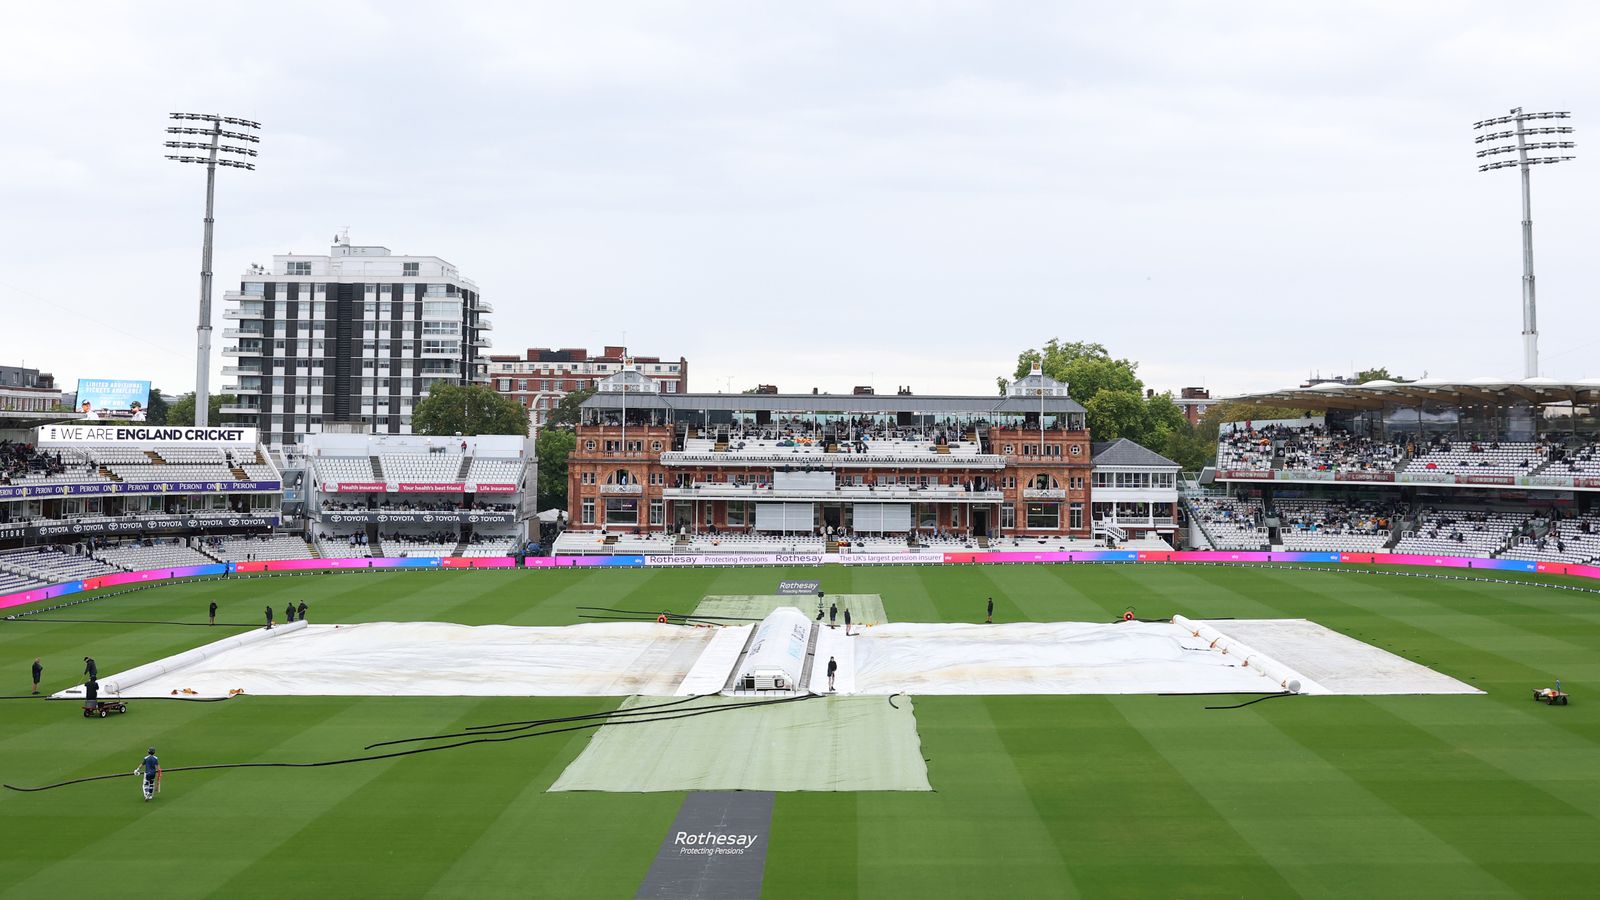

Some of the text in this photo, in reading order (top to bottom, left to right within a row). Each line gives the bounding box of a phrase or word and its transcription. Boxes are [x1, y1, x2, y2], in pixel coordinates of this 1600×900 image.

[60, 428, 244, 441] WE ARE ENGLAND CRICKET
[650, 556, 697, 564] Rothesay
[776, 554, 823, 563] Rothesay
[780, 582, 818, 590] Rothesay
[674, 832, 758, 848] Rothesay
[680, 847, 714, 856] Protecting
